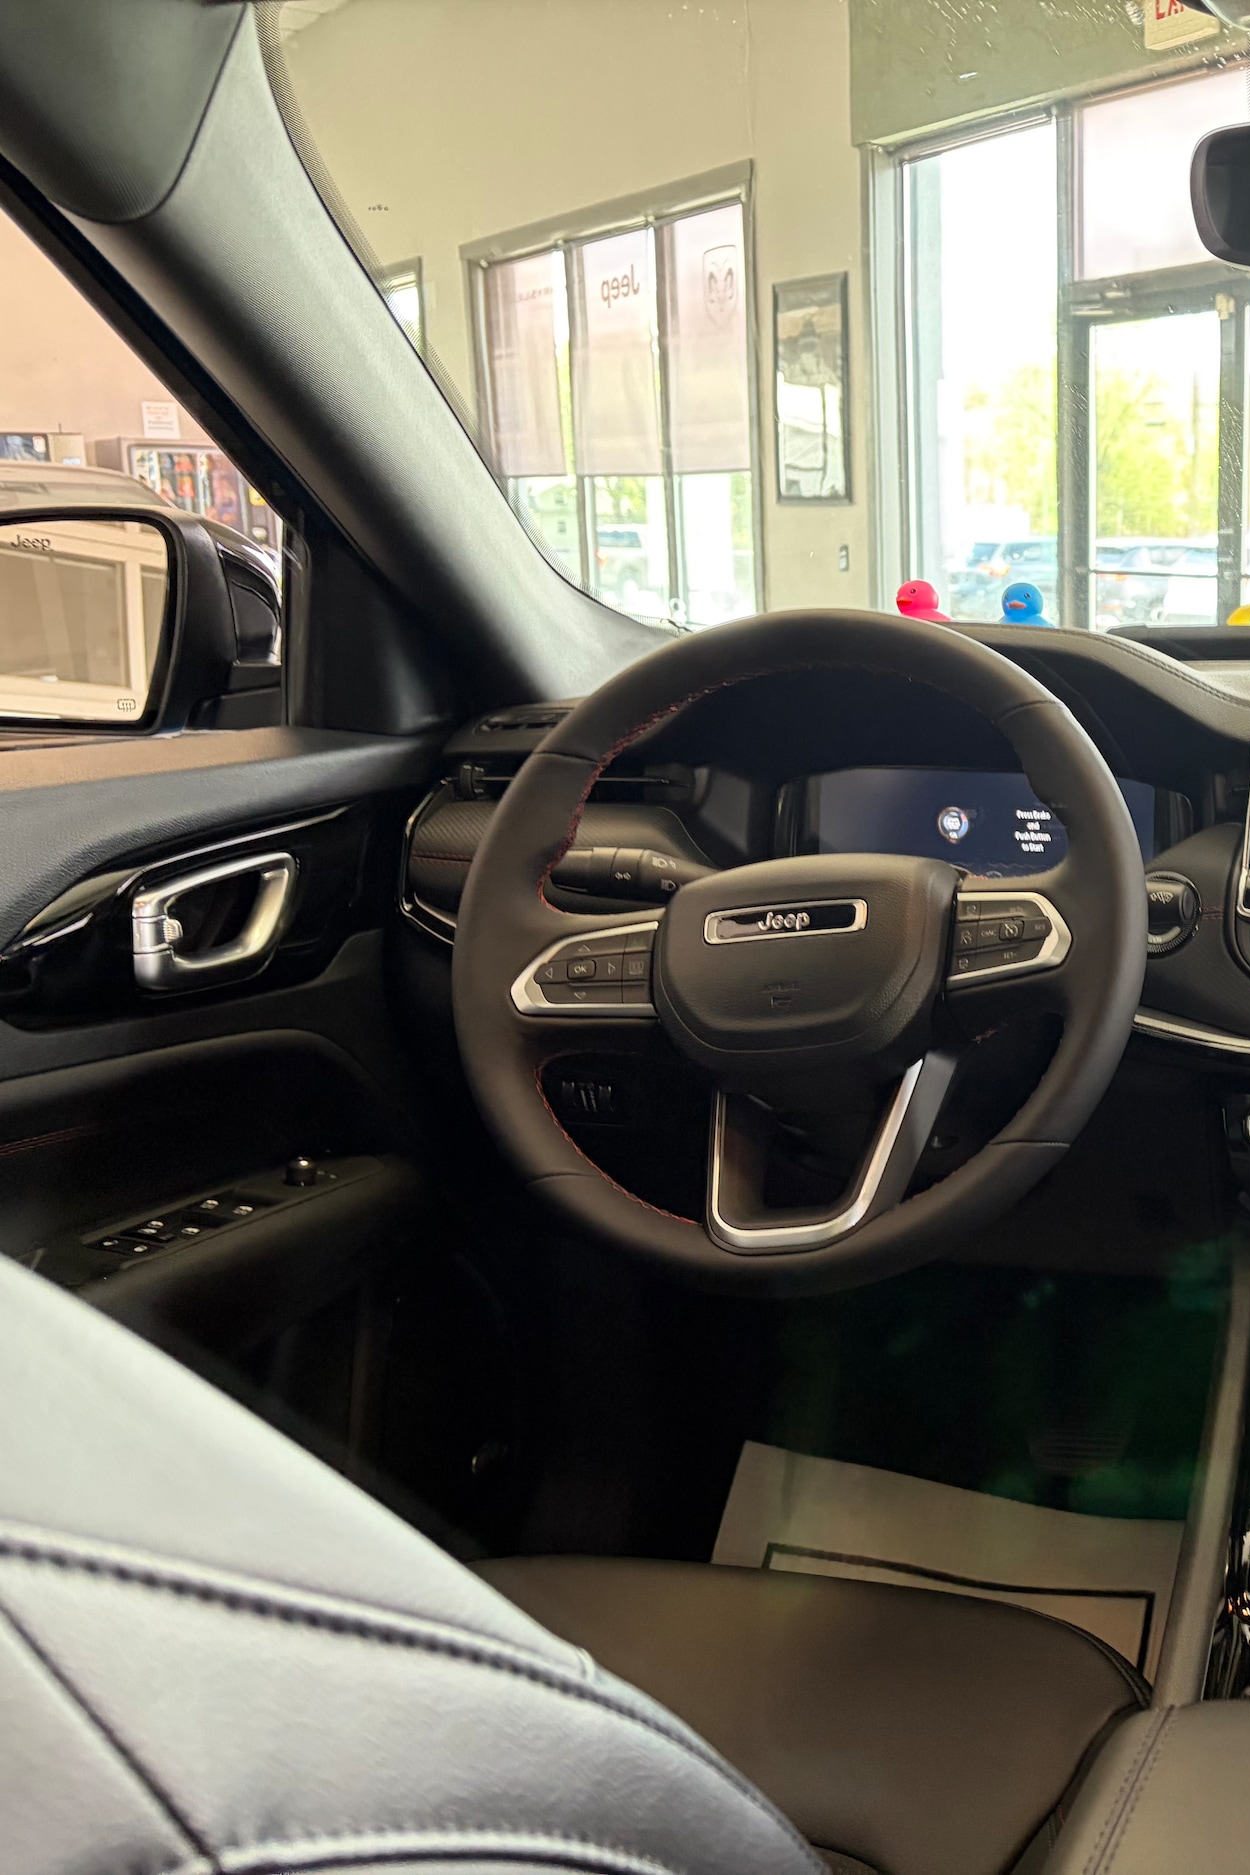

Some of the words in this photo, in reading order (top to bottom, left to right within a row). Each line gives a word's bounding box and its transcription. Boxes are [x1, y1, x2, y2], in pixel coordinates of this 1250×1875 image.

[11, 534, 51, 551] Jeep
[1015, 831, 1031, 841] Push
[1030, 831, 1051, 842] Button
[757, 911, 811, 932] Jeep
[573, 965, 588, 974] OK
